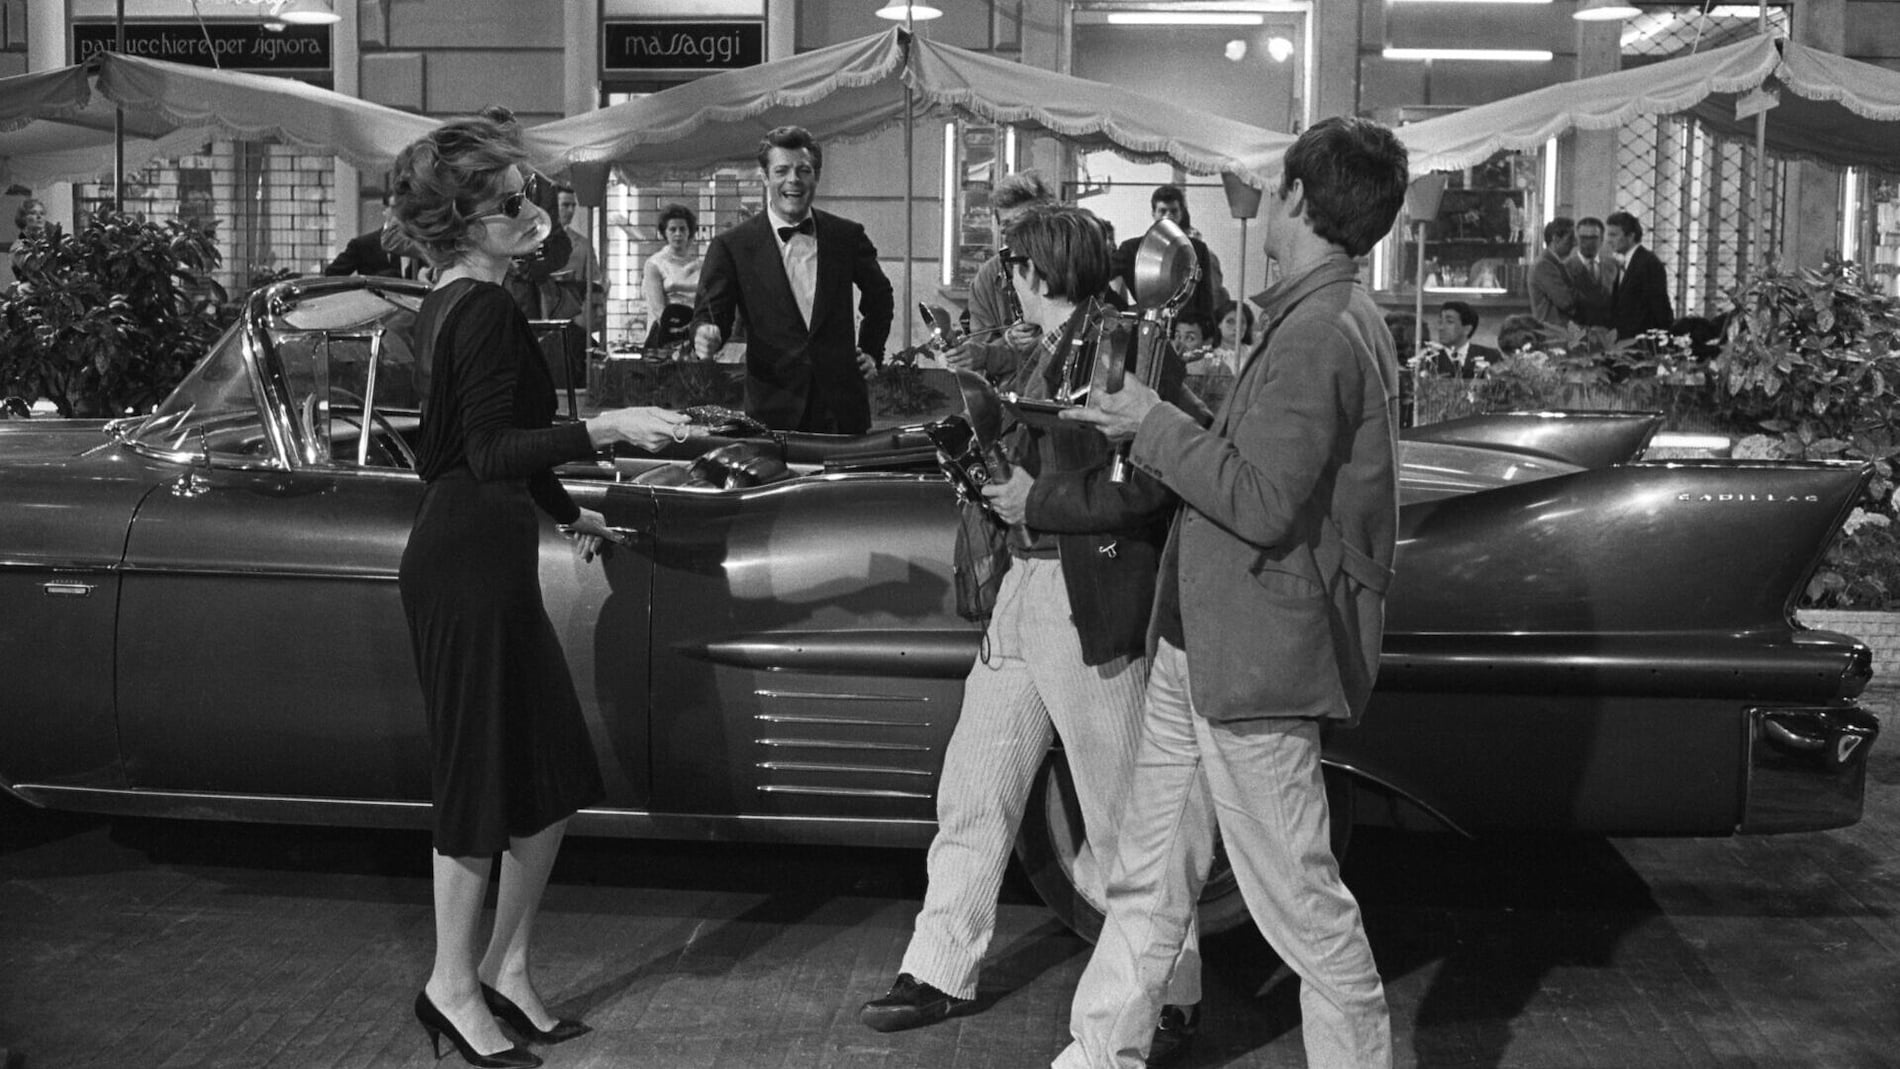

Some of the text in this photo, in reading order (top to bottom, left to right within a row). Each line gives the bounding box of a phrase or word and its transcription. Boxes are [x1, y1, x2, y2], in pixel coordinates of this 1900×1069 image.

[81, 32, 321, 61] parucchiere per signora
[625, 30, 740, 62] massaggi
[1677, 493, 1819, 502] CADILLAC
